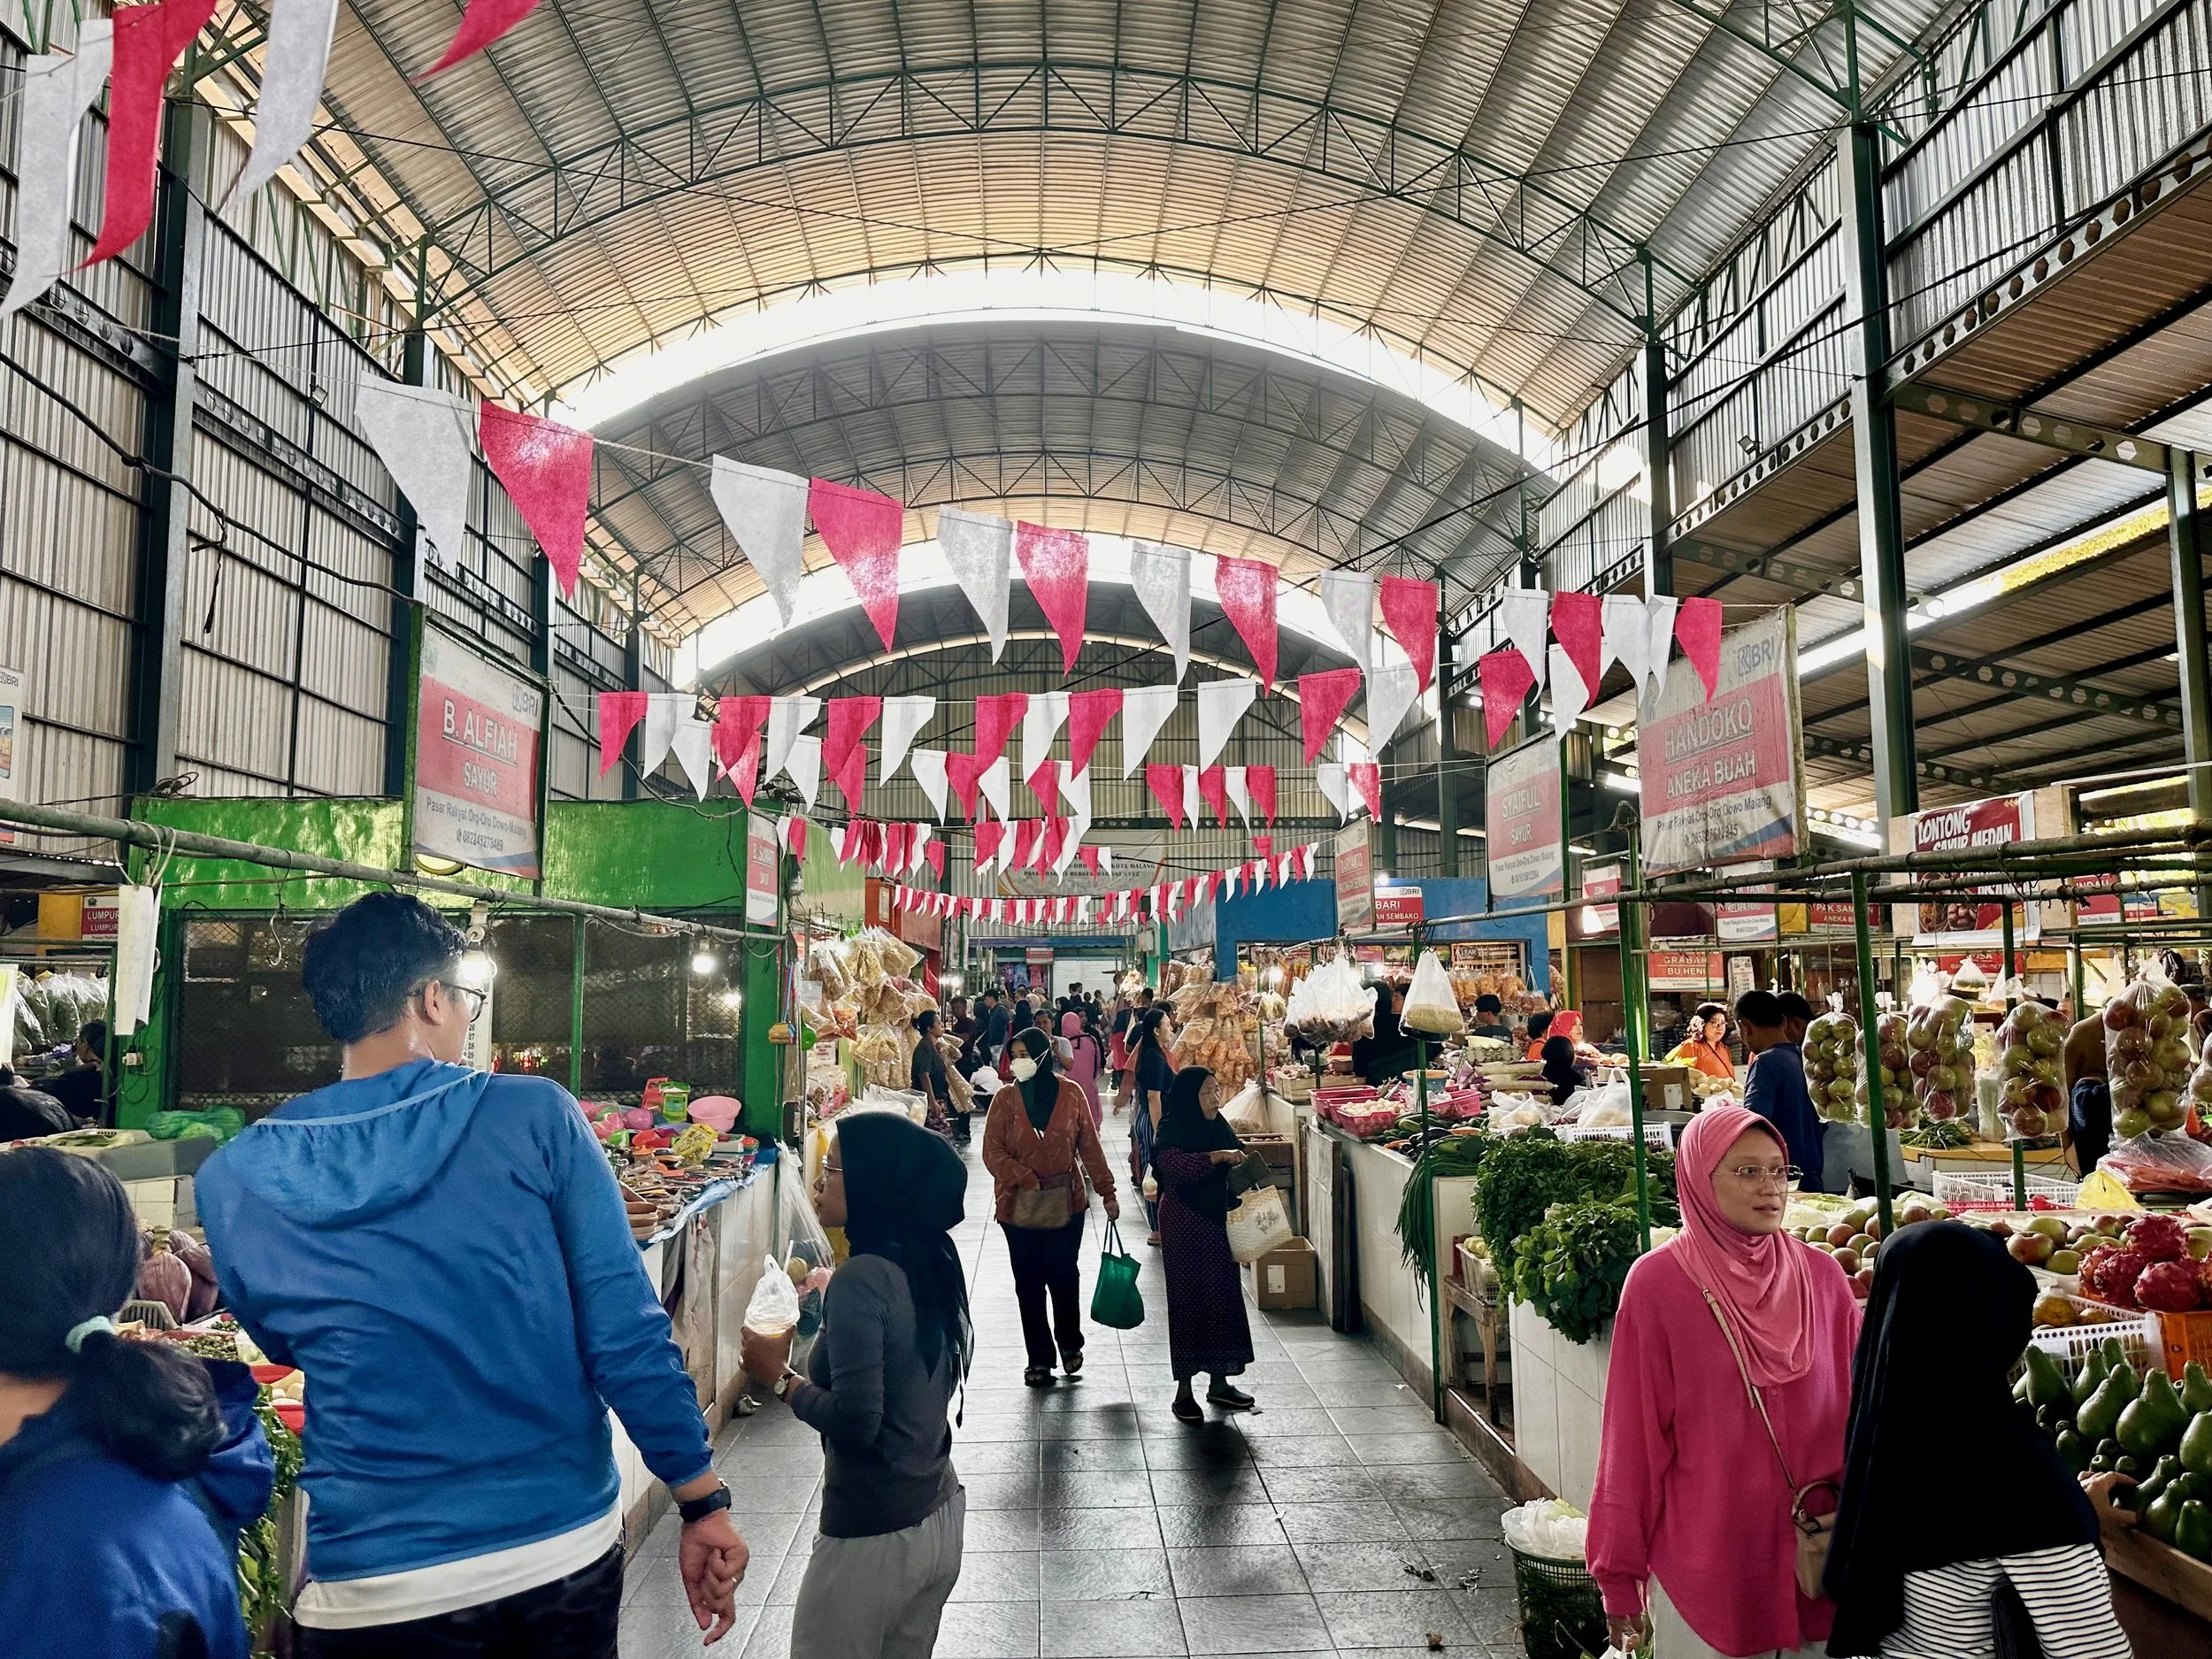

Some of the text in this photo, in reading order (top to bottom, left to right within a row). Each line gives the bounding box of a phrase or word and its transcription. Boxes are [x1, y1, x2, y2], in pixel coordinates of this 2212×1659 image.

[1751, 636, 1774, 667] BRI
[7, 675, 19, 687] BRI
[522, 691, 539, 718] BRI
[443, 698, 518, 763] B. ALFIAH
[1663, 697, 1754, 758] HANDOKO
[464, 761, 497, 795] SAYUR
[1667, 749, 1757, 799] ANEKA BUAH
[426, 796, 445, 813] Pasar
[446, 802, 467, 823] Rakyat
[1502, 784, 1540, 818] SYAIFUL
[1724, 804, 1743, 816] Dowo
[1744, 796, 1771, 810] Malang
[1510, 824, 1532, 846] SAYUR
[1918, 810, 1971, 845] LONTONG
[1971, 823, 2013, 847] MEDAN
[1375, 900, 1400, 910] BARI
[1816, 903, 1834, 912] PAK
